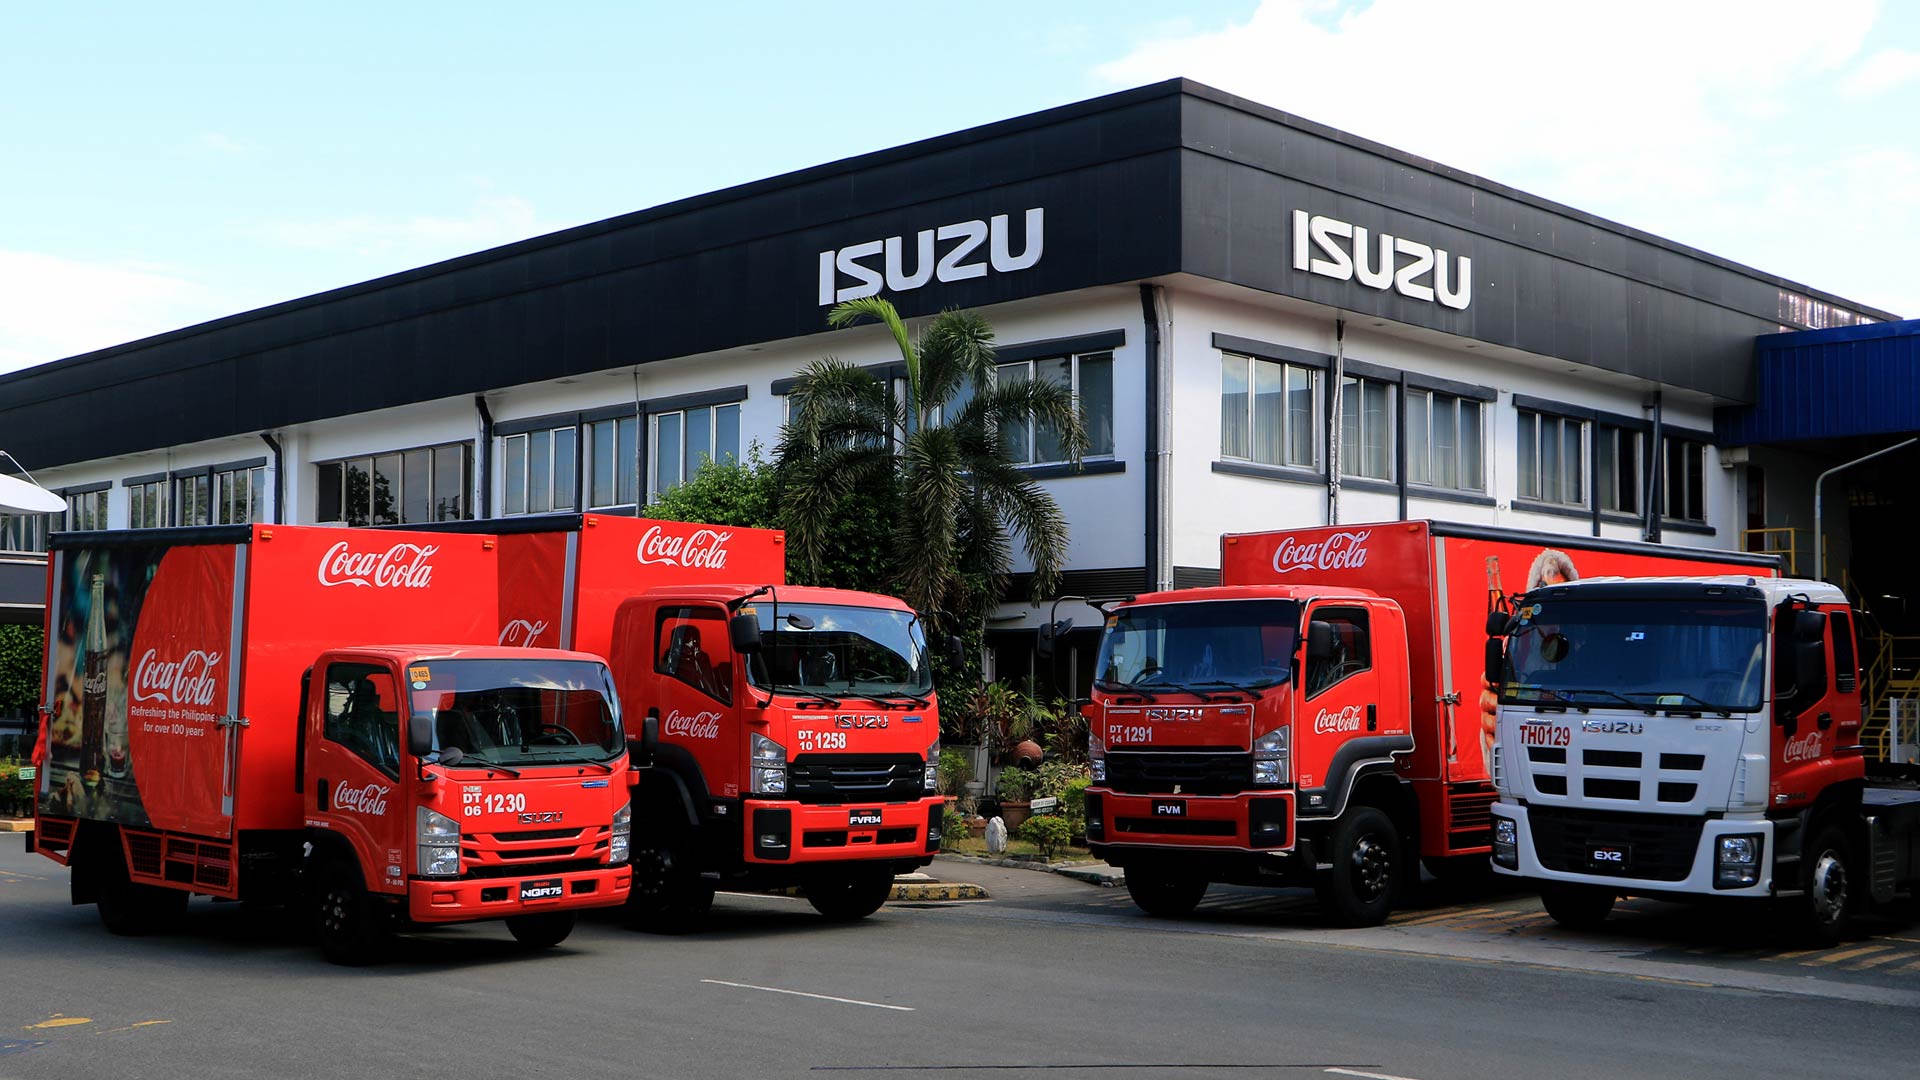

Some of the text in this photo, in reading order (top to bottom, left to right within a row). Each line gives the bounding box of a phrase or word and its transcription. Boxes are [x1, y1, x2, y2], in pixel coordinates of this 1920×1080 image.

[818, 207, 1044, 306] ISUZU
[1292, 209, 1472, 311] ISUZU
[1272, 529, 1372, 574] Coca-Cola
[317, 541, 440, 588] Coca-Cola
[133, 648, 224, 706] Coca-Cola
[131, 706, 166, 719] Refreshing
[168, 708, 180, 719] the
[1145, 709, 1203, 721] ISUZU
[1314, 705, 1362, 735] Coca-Cola
[143, 721, 205, 737] for over 100 years
[664, 709, 723, 739] Coca-Cola
[834, 714, 889, 729] ISUZU
[1109, 725, 1123, 733] DT
[1582, 720, 1644, 735] ISUZU
[798, 730, 814, 740] DT
[815, 732, 847, 749] 1258
[1110, 735, 1122, 743] 14
[1124, 726, 1153, 742] 1291
[800, 741, 813, 751] 10
[334, 780, 390, 816] Coca-Cola
[463, 793, 482, 804] DT
[484, 793, 526, 814] 1230
[464, 806, 482, 817] 06
[1157, 805, 1181, 814] FVM
[518, 811, 564, 824] ISUZU
[850, 815, 881, 824] FVR34
[1593, 850, 1622, 861] EXZ
[521, 886, 562, 898] NQR75
